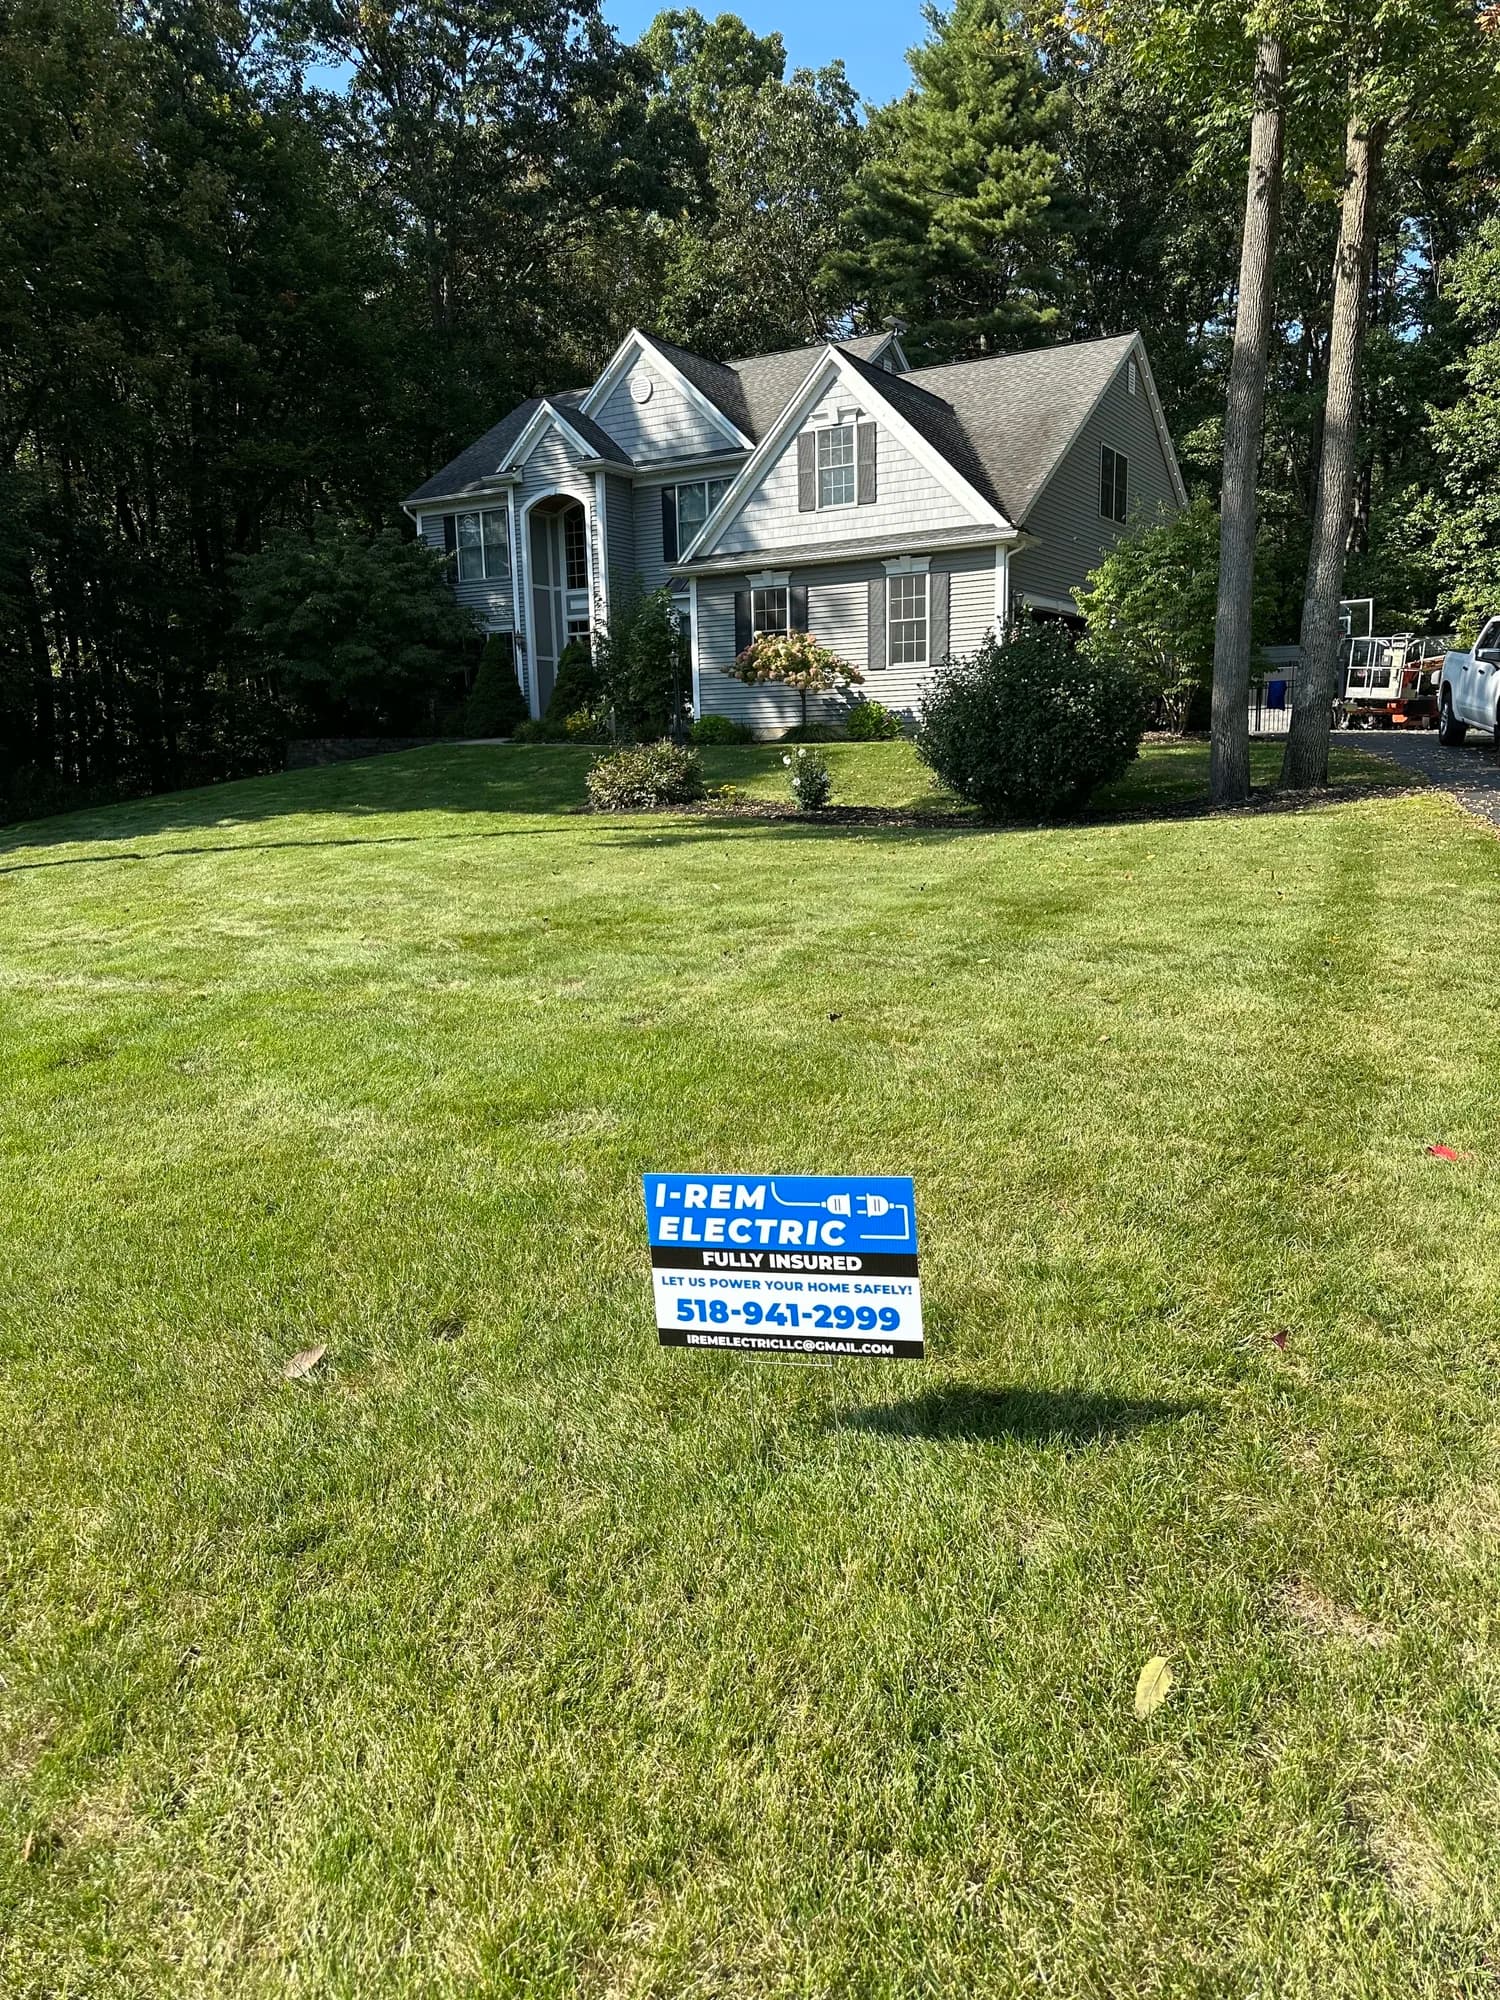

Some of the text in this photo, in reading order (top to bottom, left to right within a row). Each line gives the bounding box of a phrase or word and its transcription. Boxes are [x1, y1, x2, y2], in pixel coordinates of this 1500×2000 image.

[654, 1182, 767, 1210] I-REM
[658, 1215, 847, 1247] ELECTRIC
[702, 1251, 863, 1271] FULLY INSURED
[661, 1276, 913, 1295] LET US POWER YOUR HOME SAFELY!
[676, 1298, 901, 1332] 518-941-2999
[687, 1334, 894, 1355] IREMELECTRICLLC@GMAIL.COM
